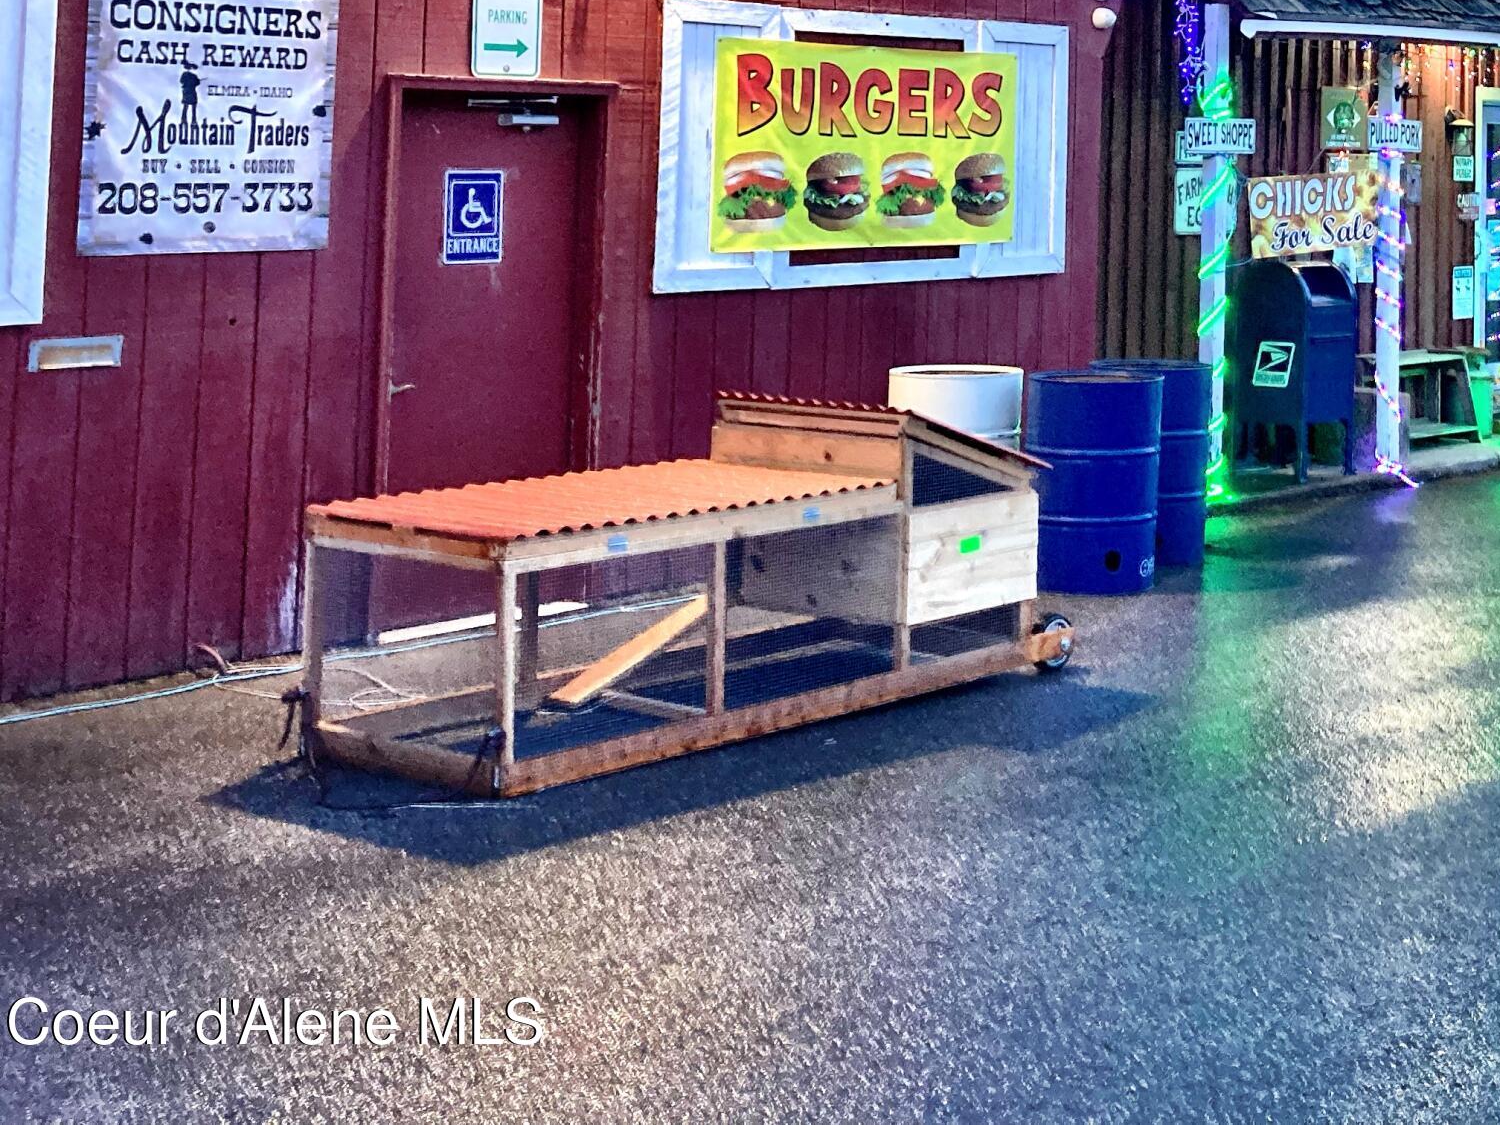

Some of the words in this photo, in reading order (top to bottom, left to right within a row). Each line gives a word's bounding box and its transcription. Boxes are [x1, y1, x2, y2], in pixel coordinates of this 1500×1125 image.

[488, 9, 527, 25] PARKING
[117, 39, 190, 66] CASH
[202, 44, 308, 70] REWARD
[207, 85, 250, 98] ELMIRA
[260, 86, 293, 98] IDAHO
[736, 53, 1003, 139] BURGERS
[121, 99, 235, 154] Mountain
[229, 104, 309, 154] Traders
[1188, 122, 1218, 149] SWEET
[1221, 123, 1253, 149] SHOPPE
[1371, 122, 1398, 147] PULLED
[1401, 124, 1420, 150] PORK
[142, 159, 167, 174] BUY
[190, 159, 221, 174] SELL
[243, 159, 295, 174] CONSIGN
[98, 182, 314, 215] 208-557-3733
[1250, 175, 1356, 220] CHICKS
[447, 237, 499, 254] ENTRANCE
[1271, 221, 1312, 251] For
[1320, 212, 1377, 245] Sale
